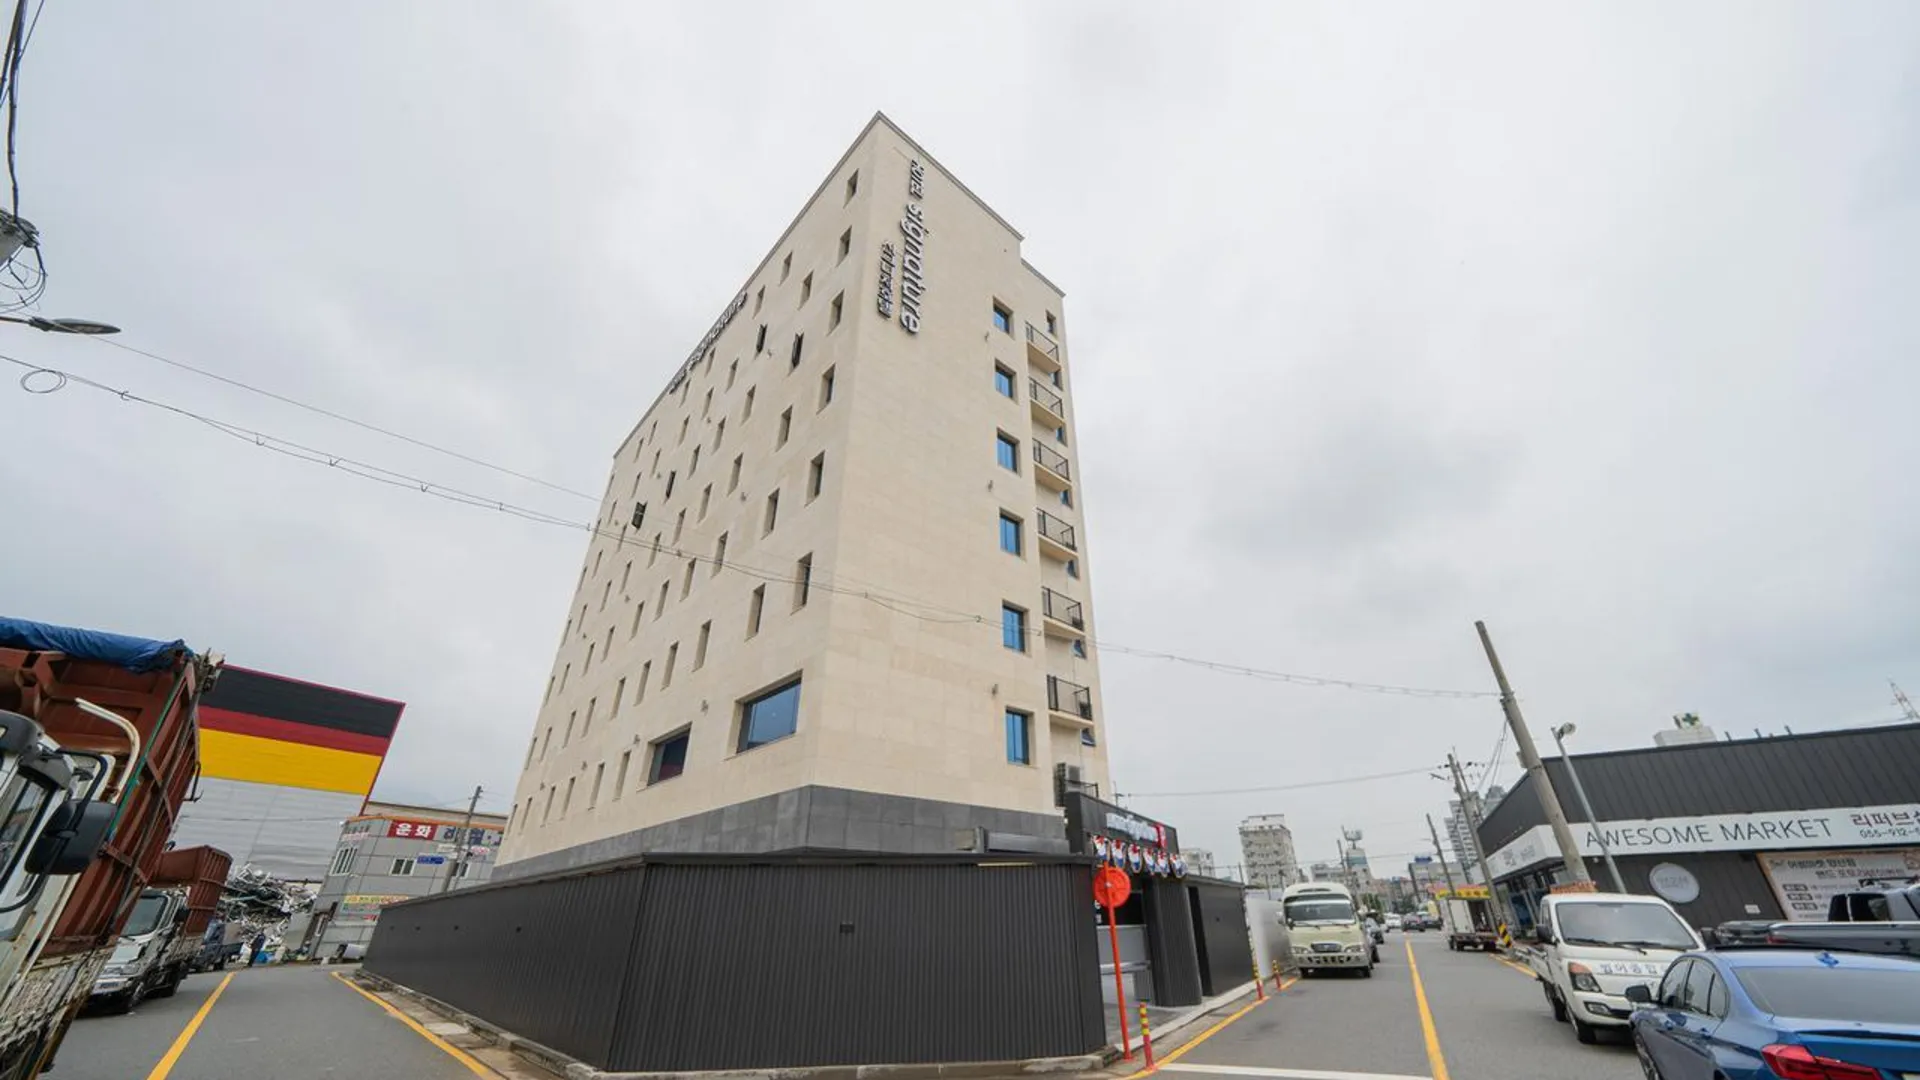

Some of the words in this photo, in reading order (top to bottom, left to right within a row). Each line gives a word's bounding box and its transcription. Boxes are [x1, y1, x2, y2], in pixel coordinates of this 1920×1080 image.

[909, 159, 924, 200] HOTEL
[899, 203, 929, 334] signature
[1586, 824, 1713, 848] AWESOME
[1720, 818, 1831, 842] MARKET
